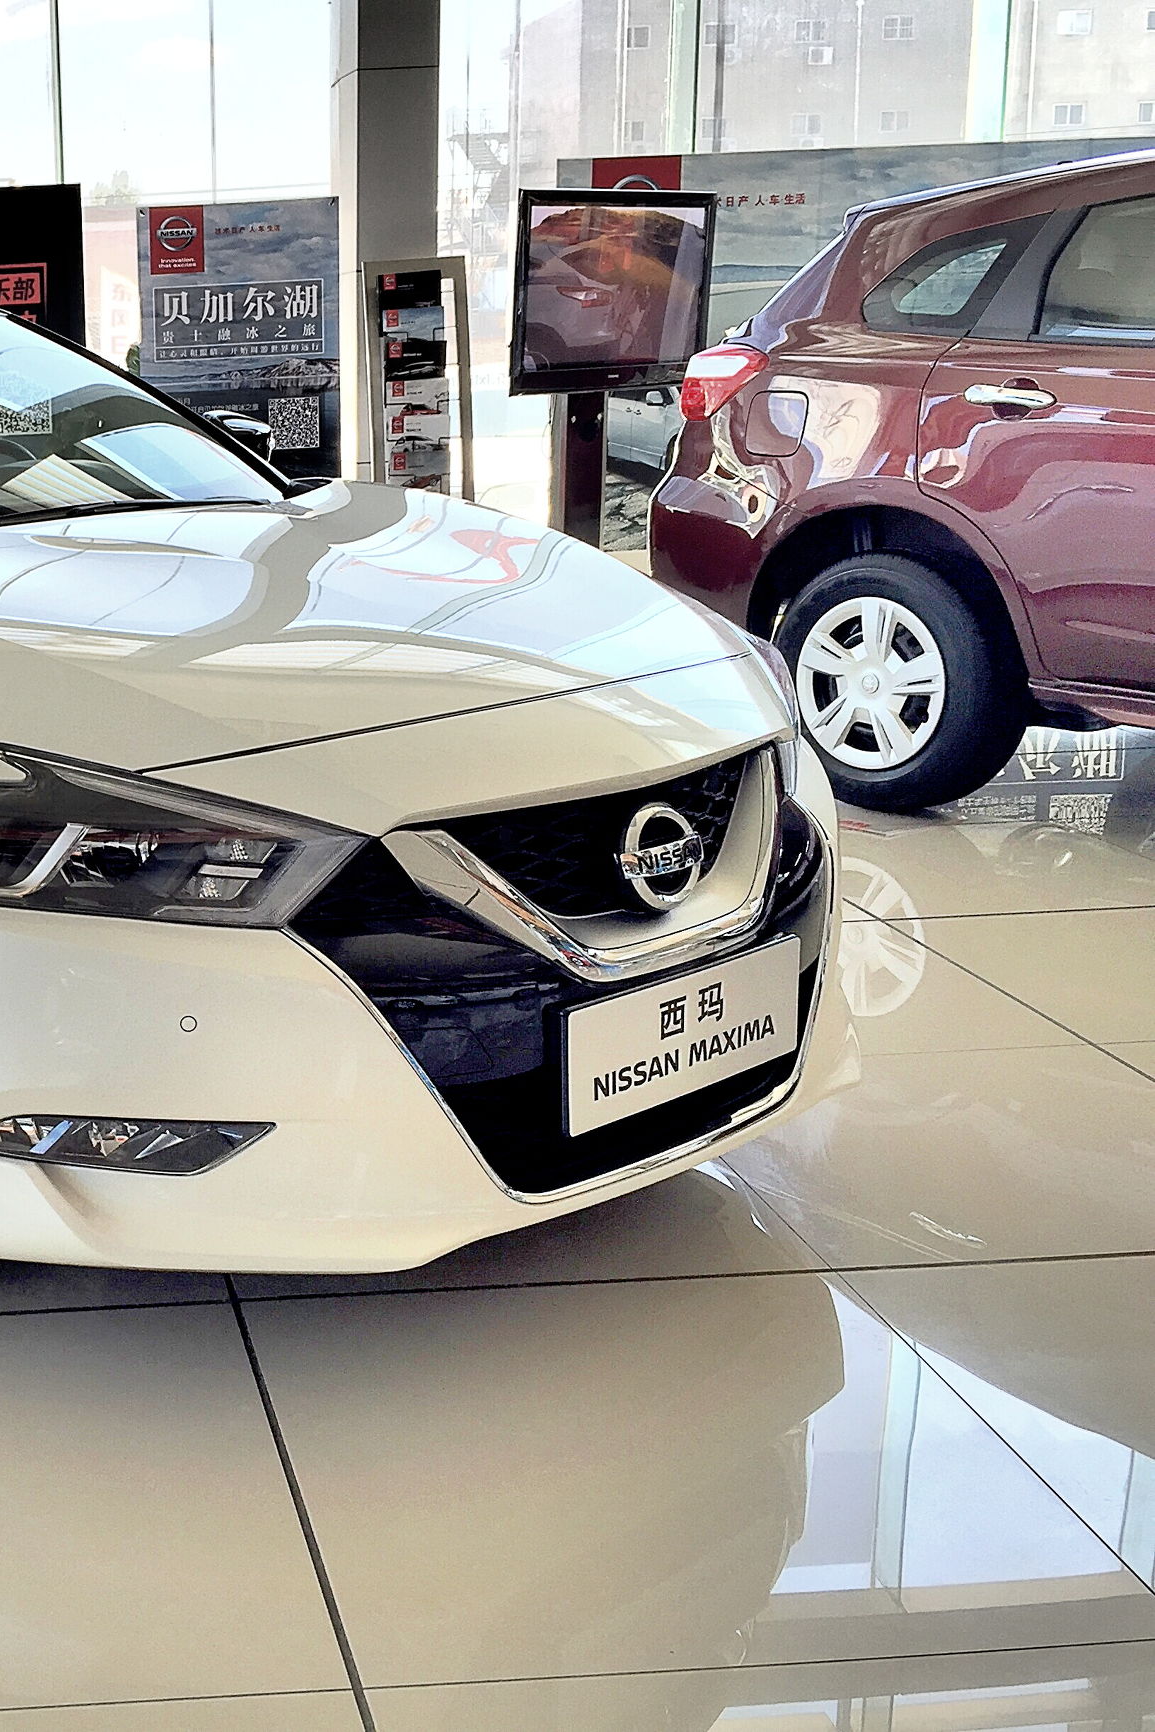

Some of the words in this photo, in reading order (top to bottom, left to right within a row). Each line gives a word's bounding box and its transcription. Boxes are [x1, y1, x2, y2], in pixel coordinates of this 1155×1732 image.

[160, 229, 194, 237] NISSAN
[161, 284, 319, 327] 贝加尔湖
[659, 981, 723, 1040] 西玛
[593, 1049, 679, 1101] NISSAN
[689, 1014, 775, 1067] MAXIMA
